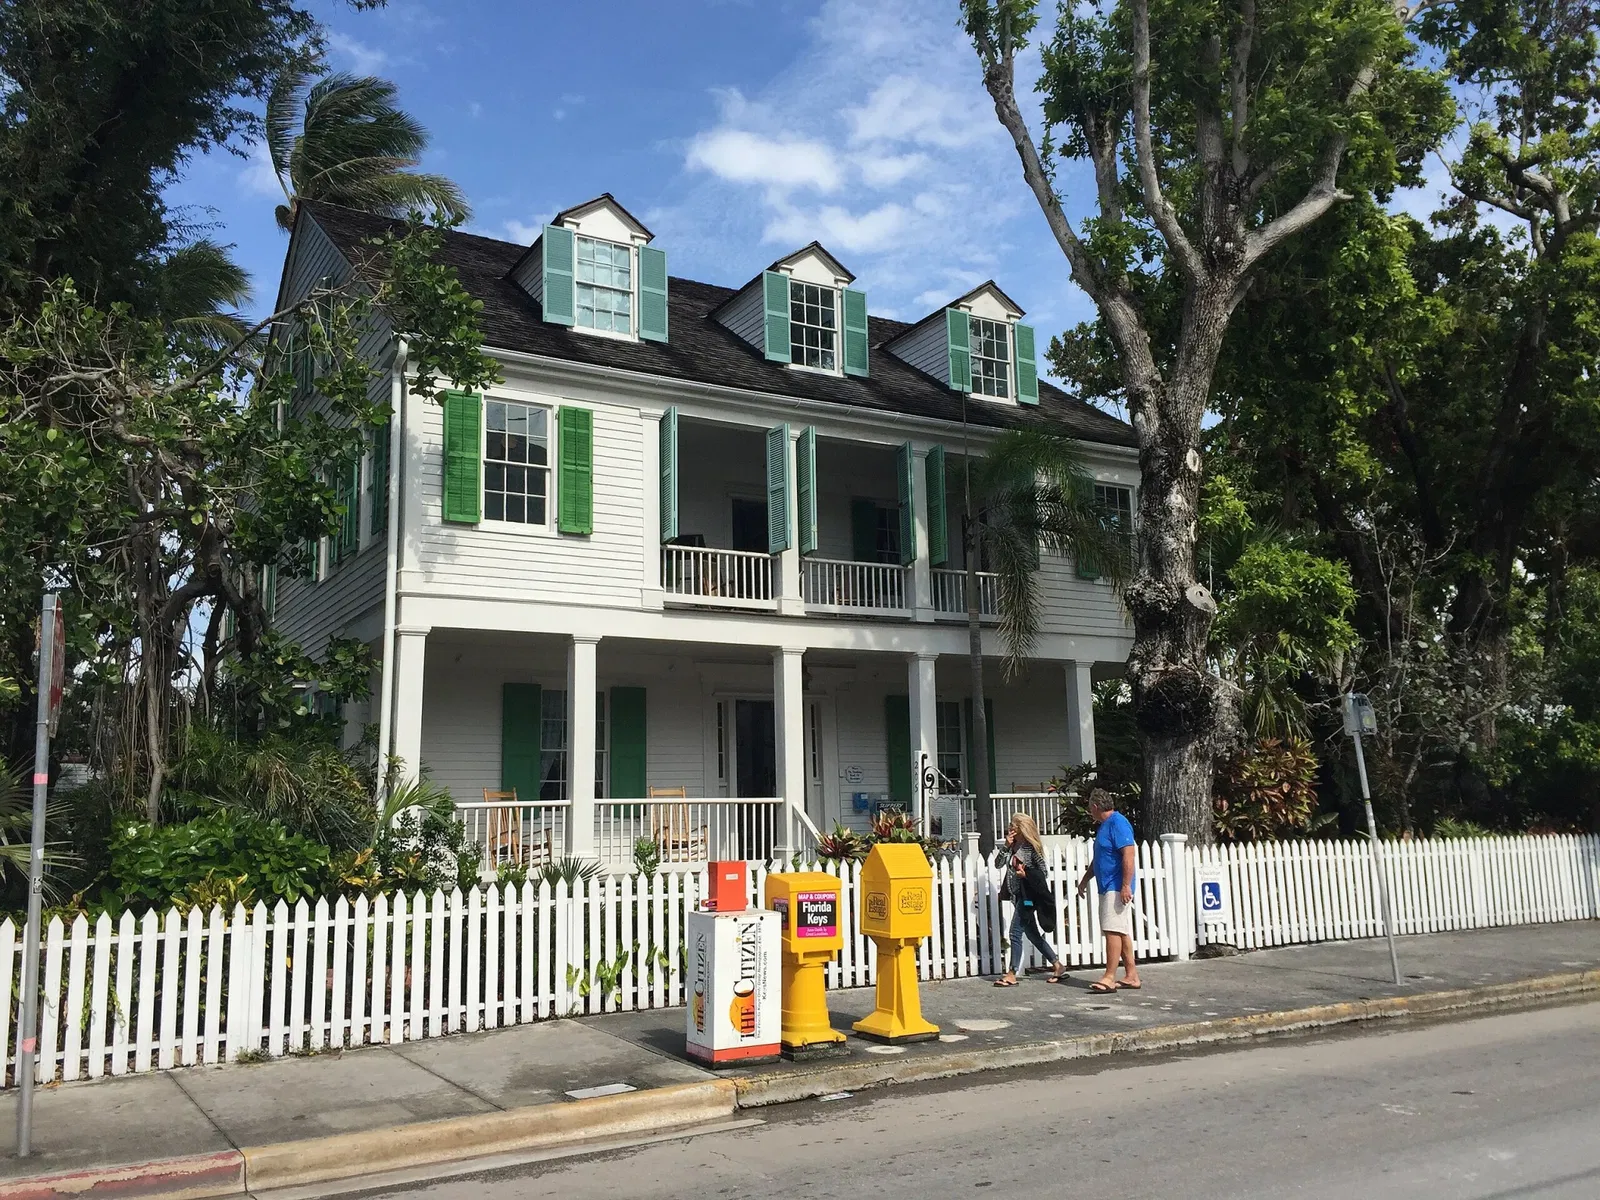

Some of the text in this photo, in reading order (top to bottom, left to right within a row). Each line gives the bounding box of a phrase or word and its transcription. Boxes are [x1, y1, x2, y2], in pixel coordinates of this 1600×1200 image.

[802, 901, 832, 913] Florida
[901, 899, 924, 909] Estate
[807, 913, 828, 927] Keys
[694, 932, 705, 1036] THE CITIZEN
[733, 922, 755, 1042] THE CITIZEN
